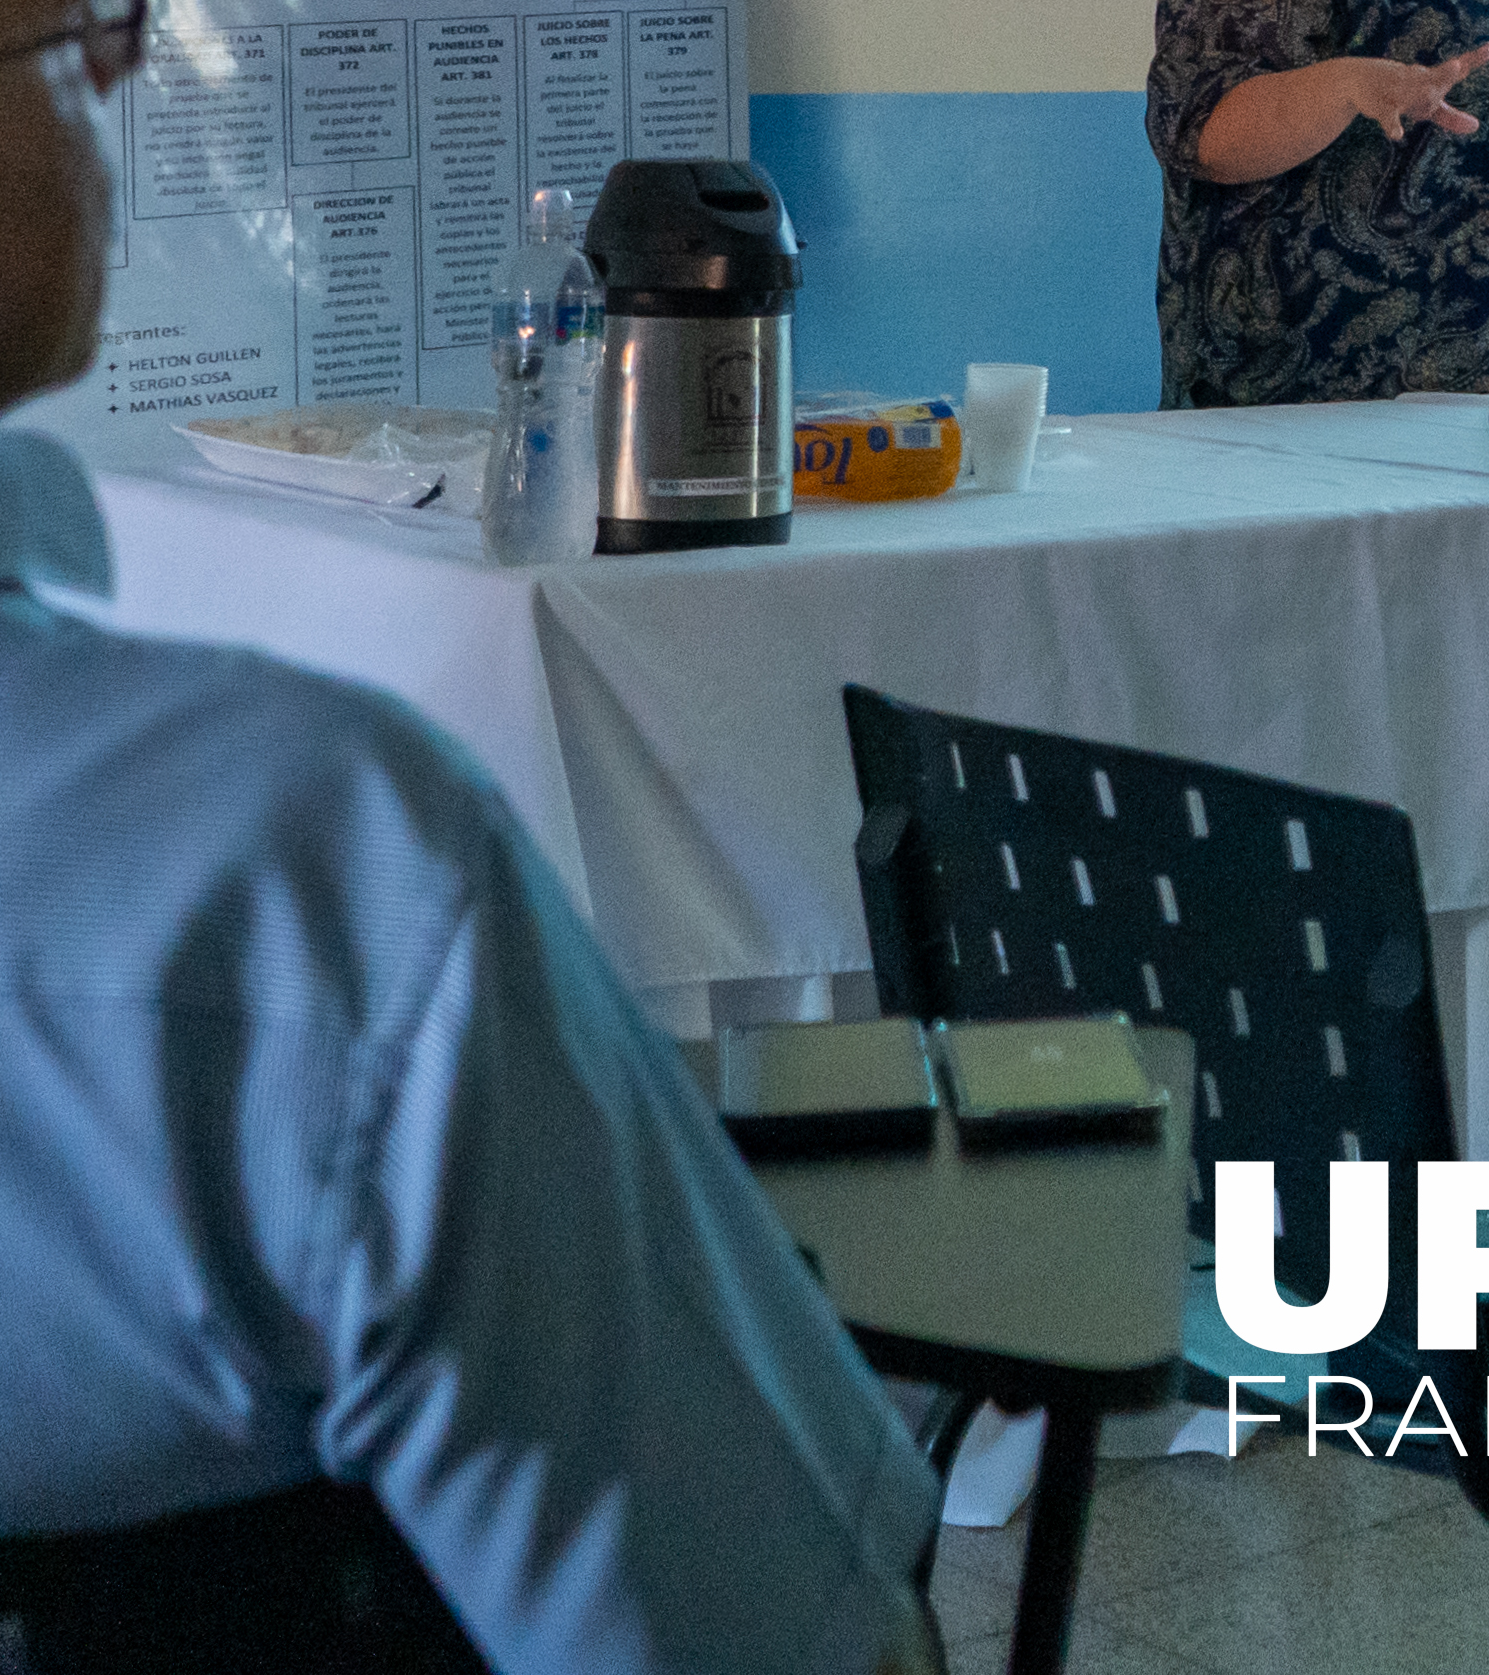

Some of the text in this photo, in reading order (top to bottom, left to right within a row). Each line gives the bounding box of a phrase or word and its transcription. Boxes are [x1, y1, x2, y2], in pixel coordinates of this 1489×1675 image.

[537, 18, 610, 31] JUICIO SOBRE
[640, 14, 714, 27] JUICIO SOBRE
[318, 28, 377, 40] PODER DE
[441, 24, 490, 35] HECHOS
[640, 29, 714, 42] LA PENA ART.
[429, 38, 504, 51] PUNIBLES EN
[541, 34, 608, 46] LOS HECHOS
[300, 43, 397, 57] DISCIPLINA ART.
[550, 50, 576, 61] ART.
[339, 60, 359, 71] 372
[433, 54, 500, 67] AUDIENCIA
[441, 71, 468, 82] ART.
[313, 195, 394, 210] DIRECCION DE
[323, 211, 386, 224] AUDIENCIA
[128, 347, 262, 372] HELTON GUILLEN
[129, 370, 233, 393] SERGIO SOSA
[129, 385, 279, 414] MATHIAS VASQUEZ
